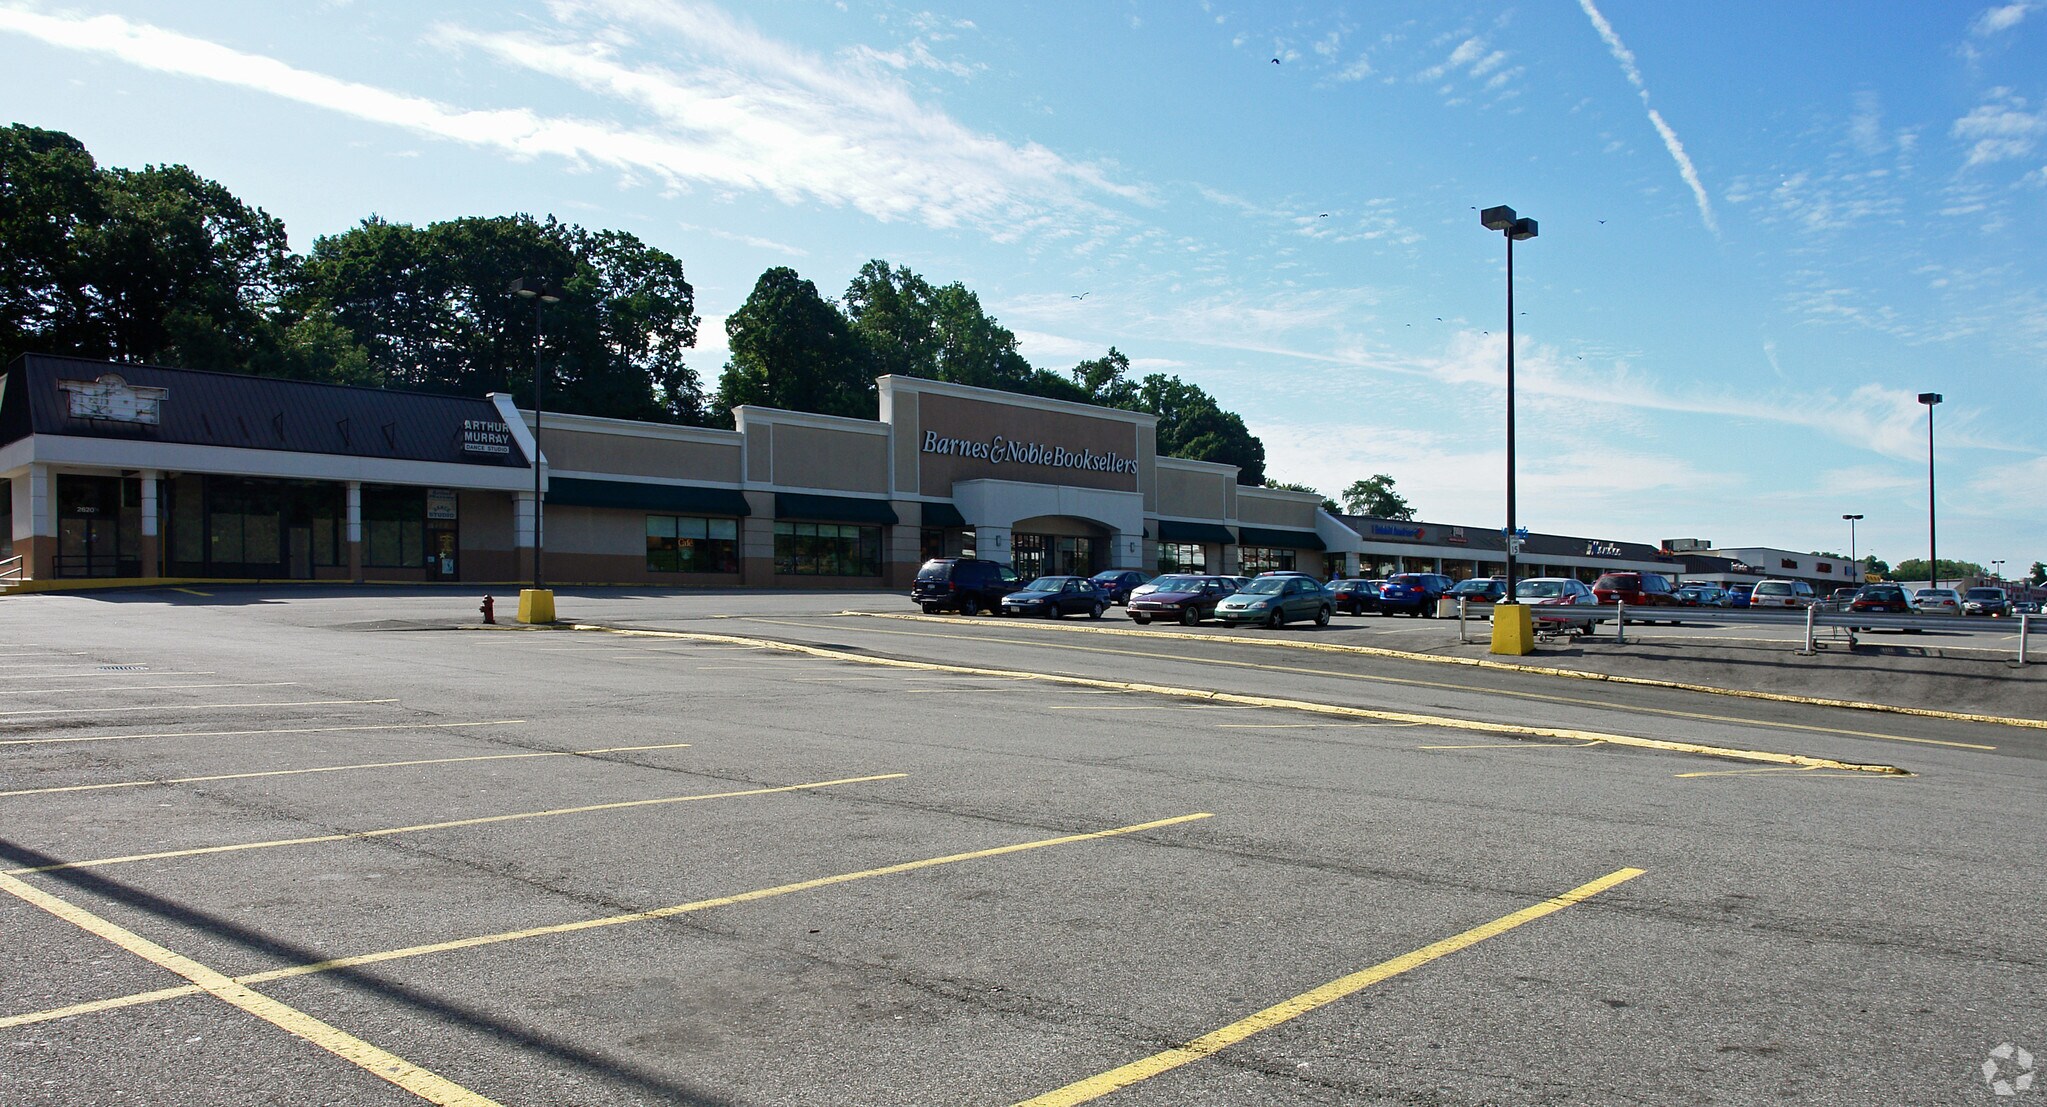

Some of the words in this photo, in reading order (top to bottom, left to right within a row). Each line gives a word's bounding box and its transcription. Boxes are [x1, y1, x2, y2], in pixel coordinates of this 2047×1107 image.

[465, 420, 509, 433] ARTHUR
[465, 431, 509, 444] MURRAY
[922, 431, 989, 459] Barnes
[990, 436, 1005, 463] &
[1005, 440, 1053, 465] Noble
[1053, 447, 1137, 474] Booksellers
[1511, 545, 1518, 553] 15
